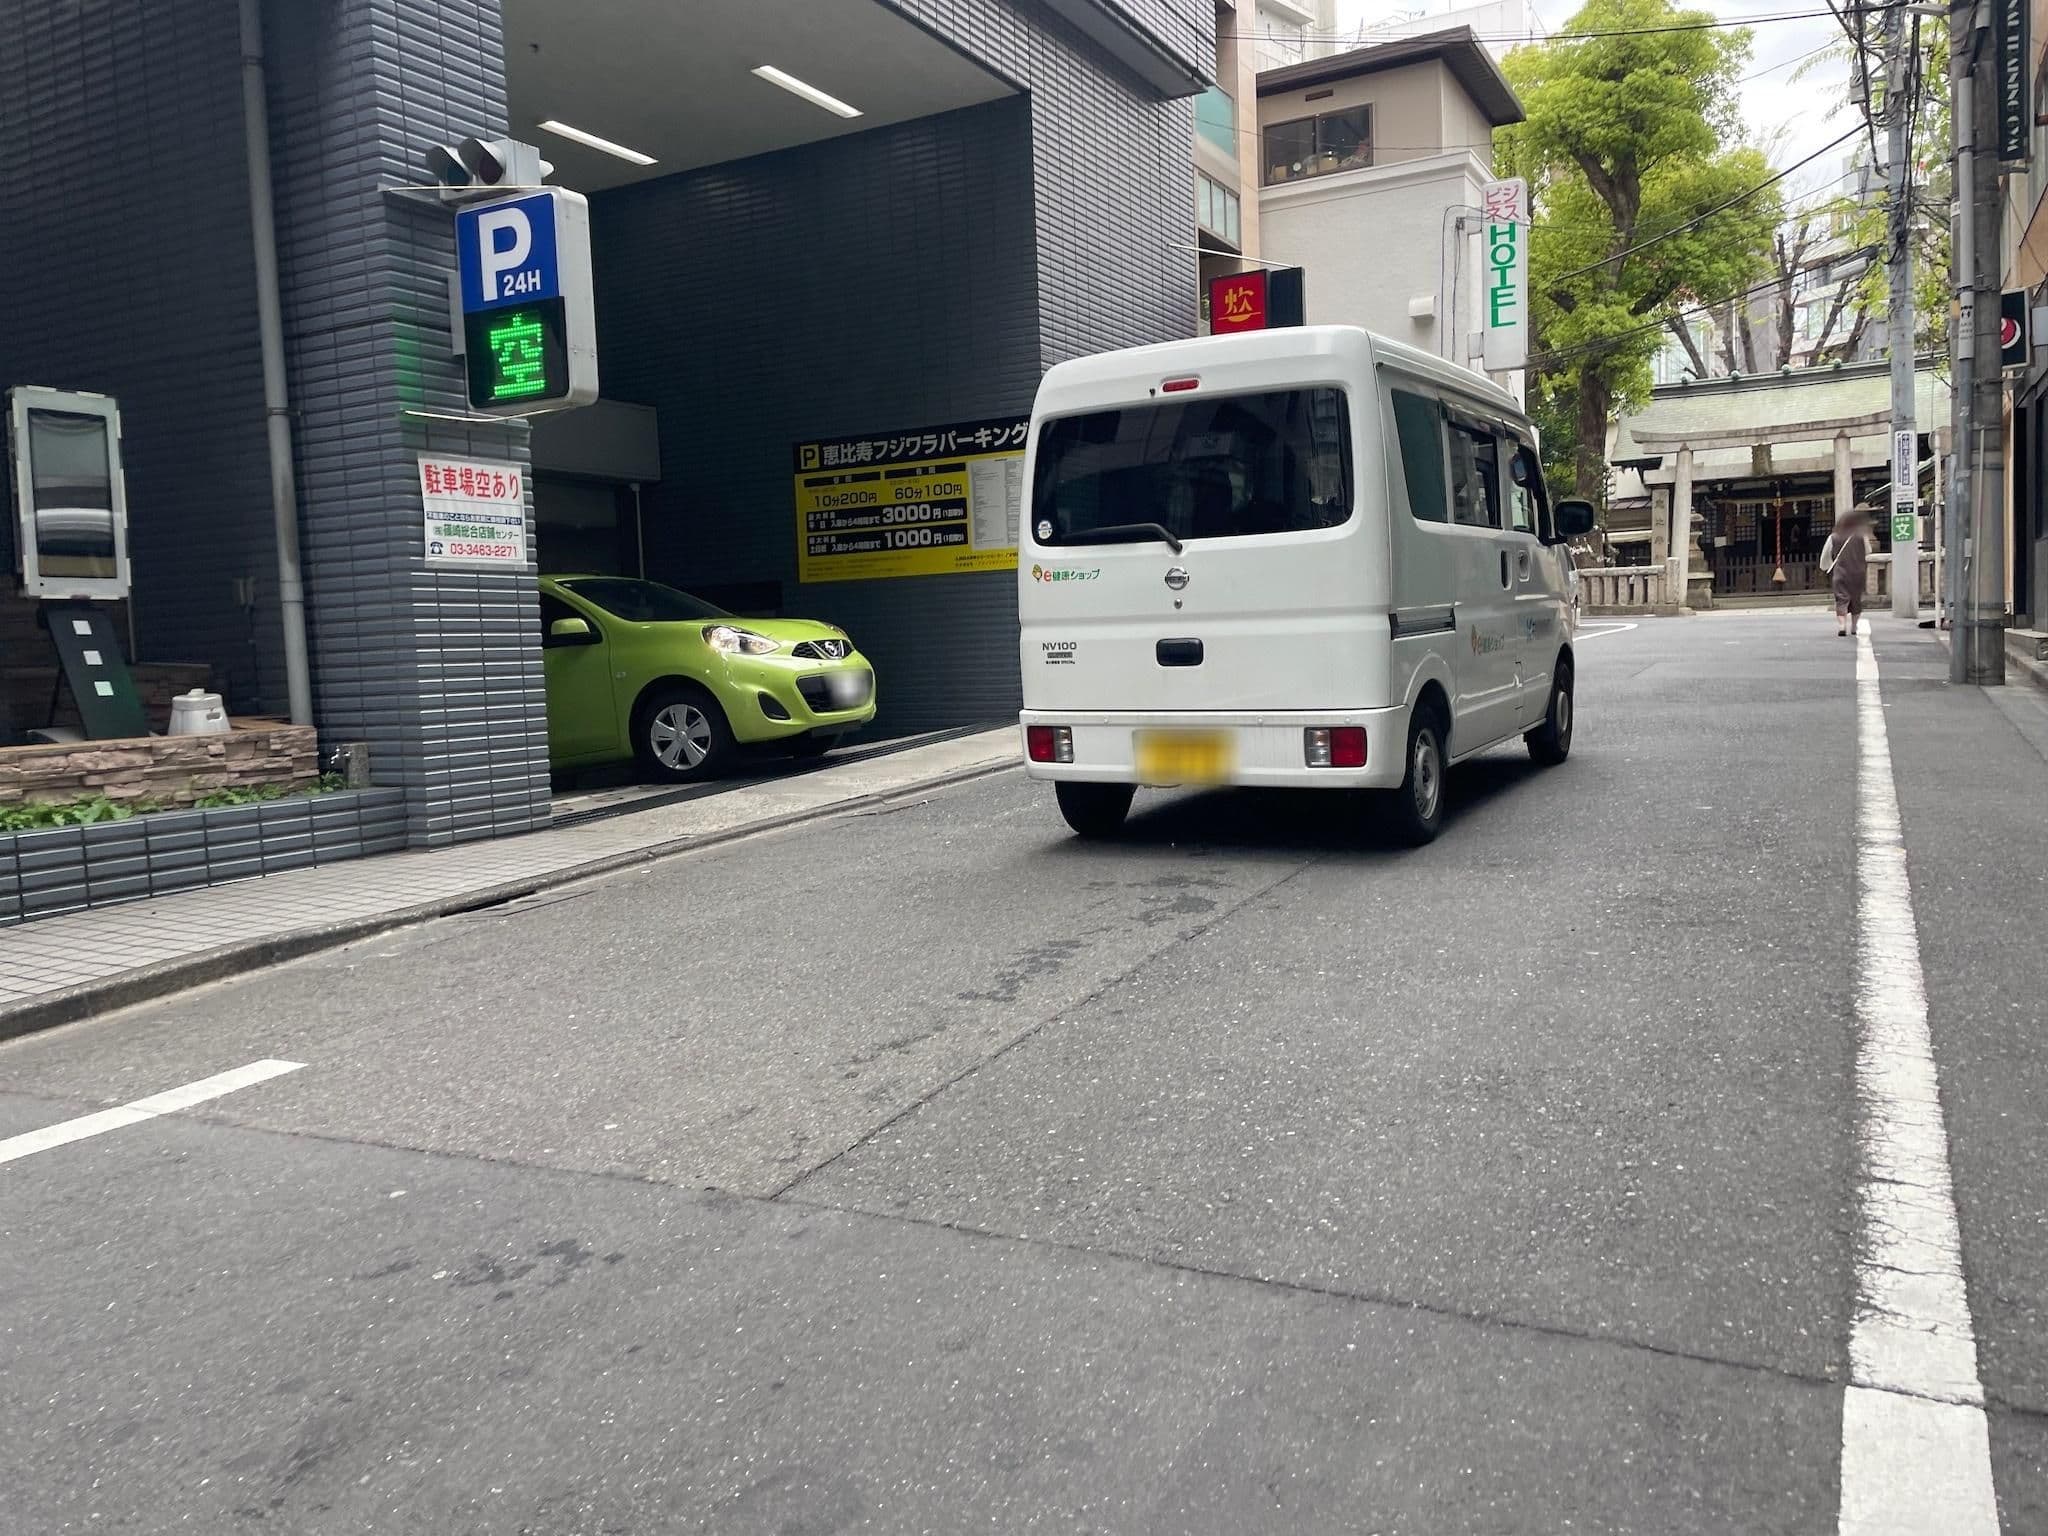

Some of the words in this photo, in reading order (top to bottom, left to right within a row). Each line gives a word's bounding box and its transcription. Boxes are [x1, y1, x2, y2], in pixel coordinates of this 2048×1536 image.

[2007, 34, 2020, 111] TRAINING
[2007, 115, 2020, 152] GYM
[478, 207, 532, 302] P
[503, 269, 541, 297] 24H
[1490, 221, 1517, 328] HOTEL
[1224, 286, 1255, 315] 炊
[490, 312, 545, 397] 空
[822, 421, 1030, 466] 恵比寿フジワラパーキング
[424, 464, 519, 500] 駐車場空あり
[450, 543, 518, 558] 03-3463-2271
[1042, 641, 1077, 651] NV100
